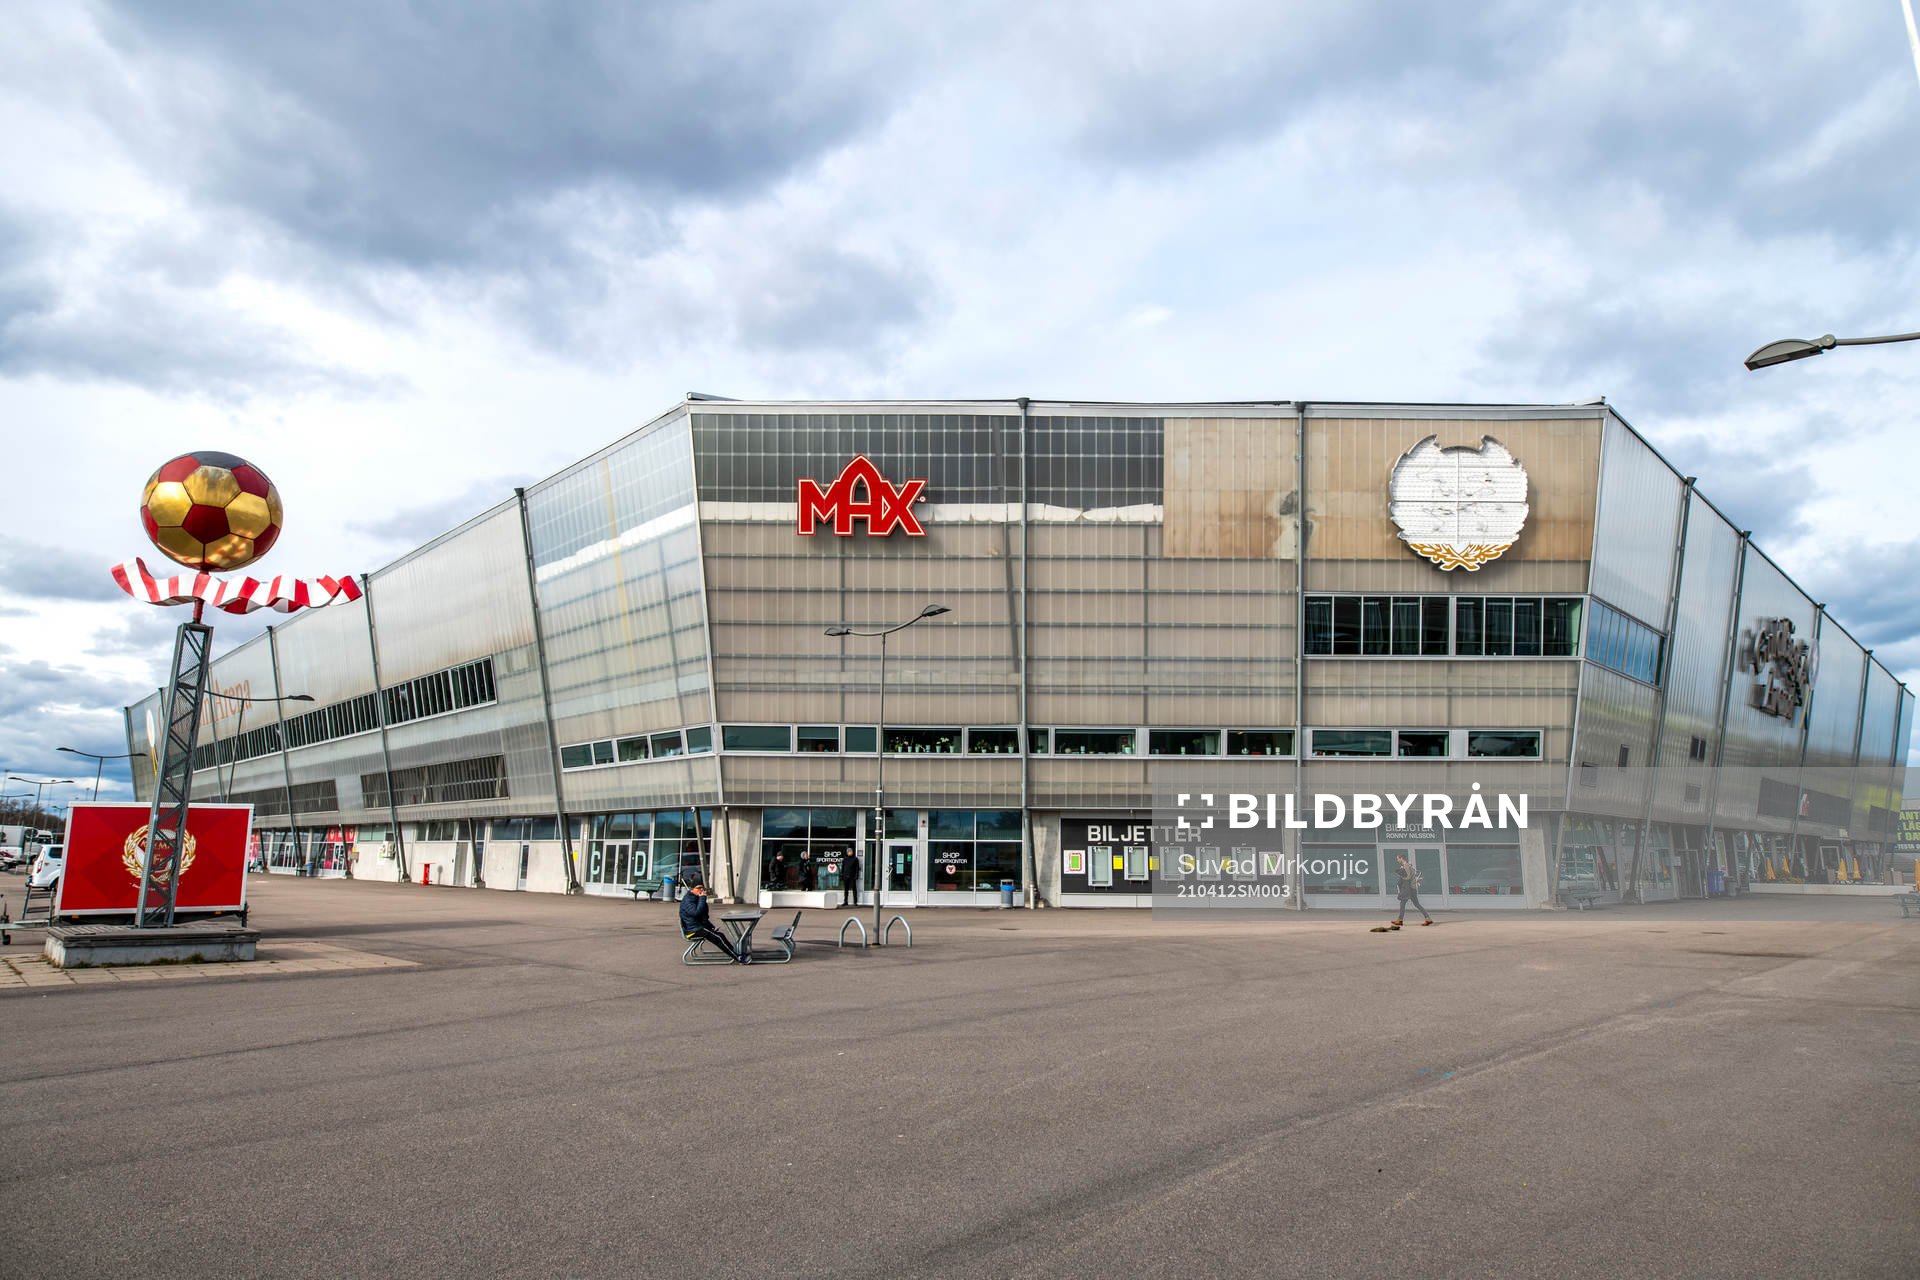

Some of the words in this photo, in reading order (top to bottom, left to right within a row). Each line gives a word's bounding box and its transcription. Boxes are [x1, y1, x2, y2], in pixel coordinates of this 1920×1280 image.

[797, 454, 928, 536] MAX
[214, 677, 252, 721] Arena
[1087, 825, 1202, 842] BILJETTER
[634, 850, 647, 876] D
